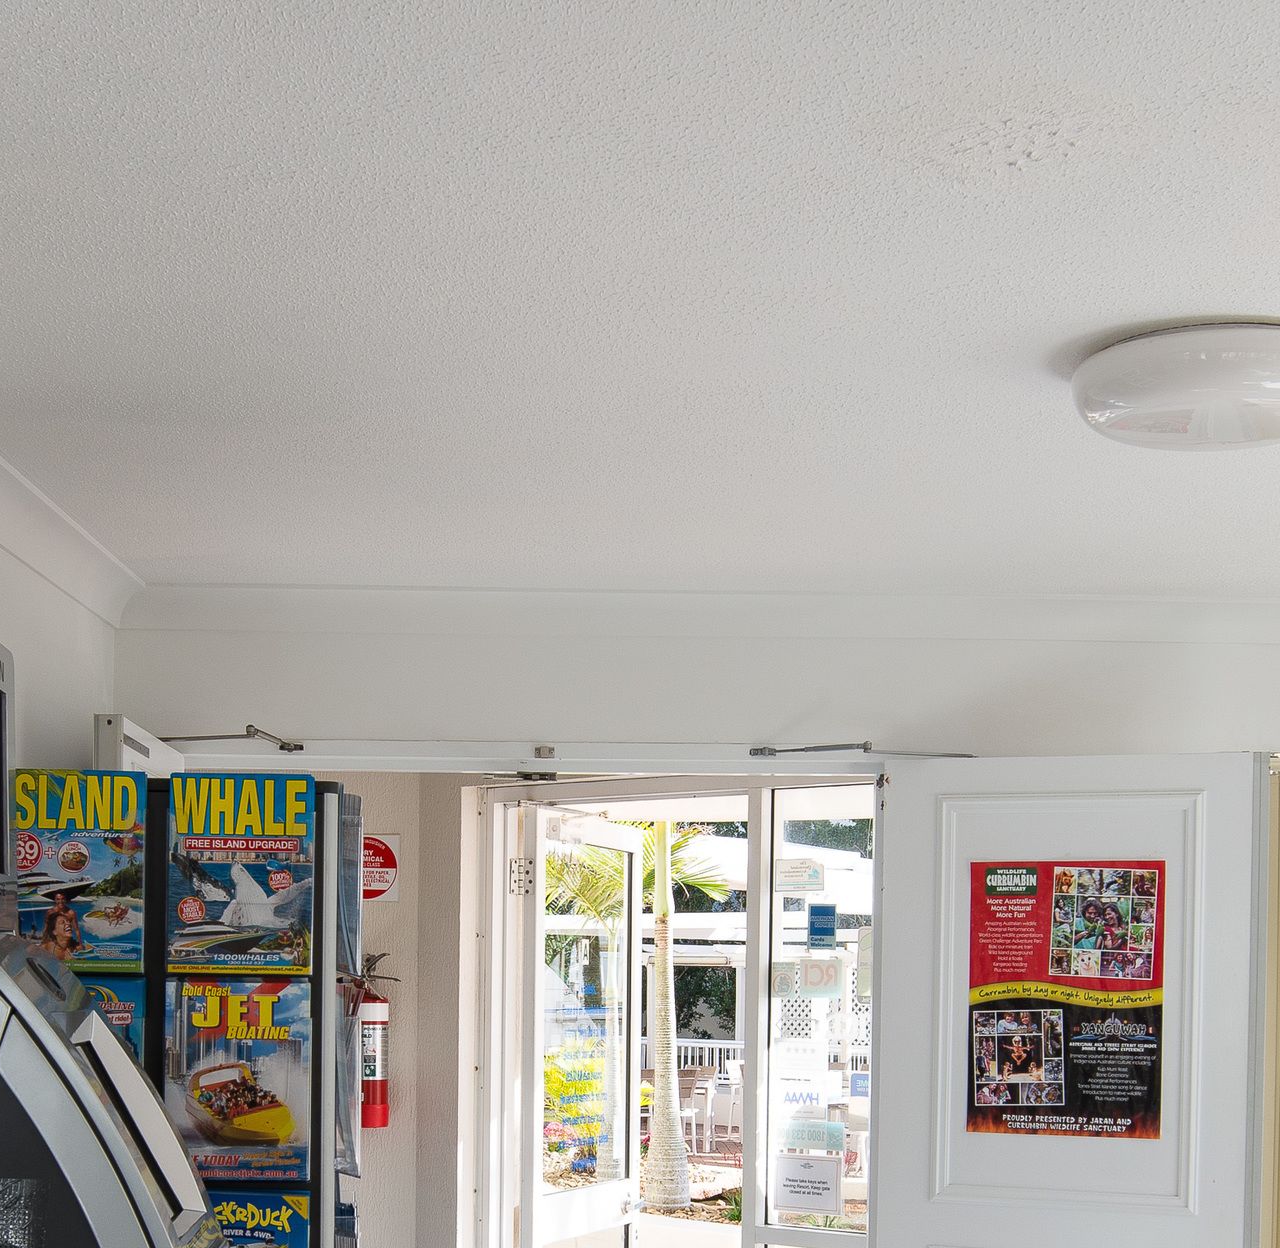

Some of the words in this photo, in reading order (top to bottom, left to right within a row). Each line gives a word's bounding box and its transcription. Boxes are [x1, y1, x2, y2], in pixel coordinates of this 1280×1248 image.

[16, 773, 138, 831] SLAND
[172, 777, 307, 836] WHALE
[186, 840, 210, 848] FREE
[212, 840, 246, 849] ISLAND
[986, 874, 1037, 887] CURRUMBIN
[182, 985, 204, 997] Gold
[205, 986, 231, 997] Coast
[1022, 986, 1032, 996] by
[1033, 986, 1049, 997] day
[192, 995, 279, 1028] JET
[226, 1026, 289, 1040] BOATING
[1002, 1114, 1033, 1122] PROUDLY
[1035, 1114, 1076, 1123] PRESENTED
[1077, 1116, 1088, 1124] BY
[1116, 1118, 1132, 1126] AND
[1007, 1122, 1048, 1130] CURRUMBIN
[1050, 1123, 1081, 1131] WILDLIFE
[1083, 1124, 1127, 1133] SANCTUARY
[203, 1154, 240, 1166] TODAY
